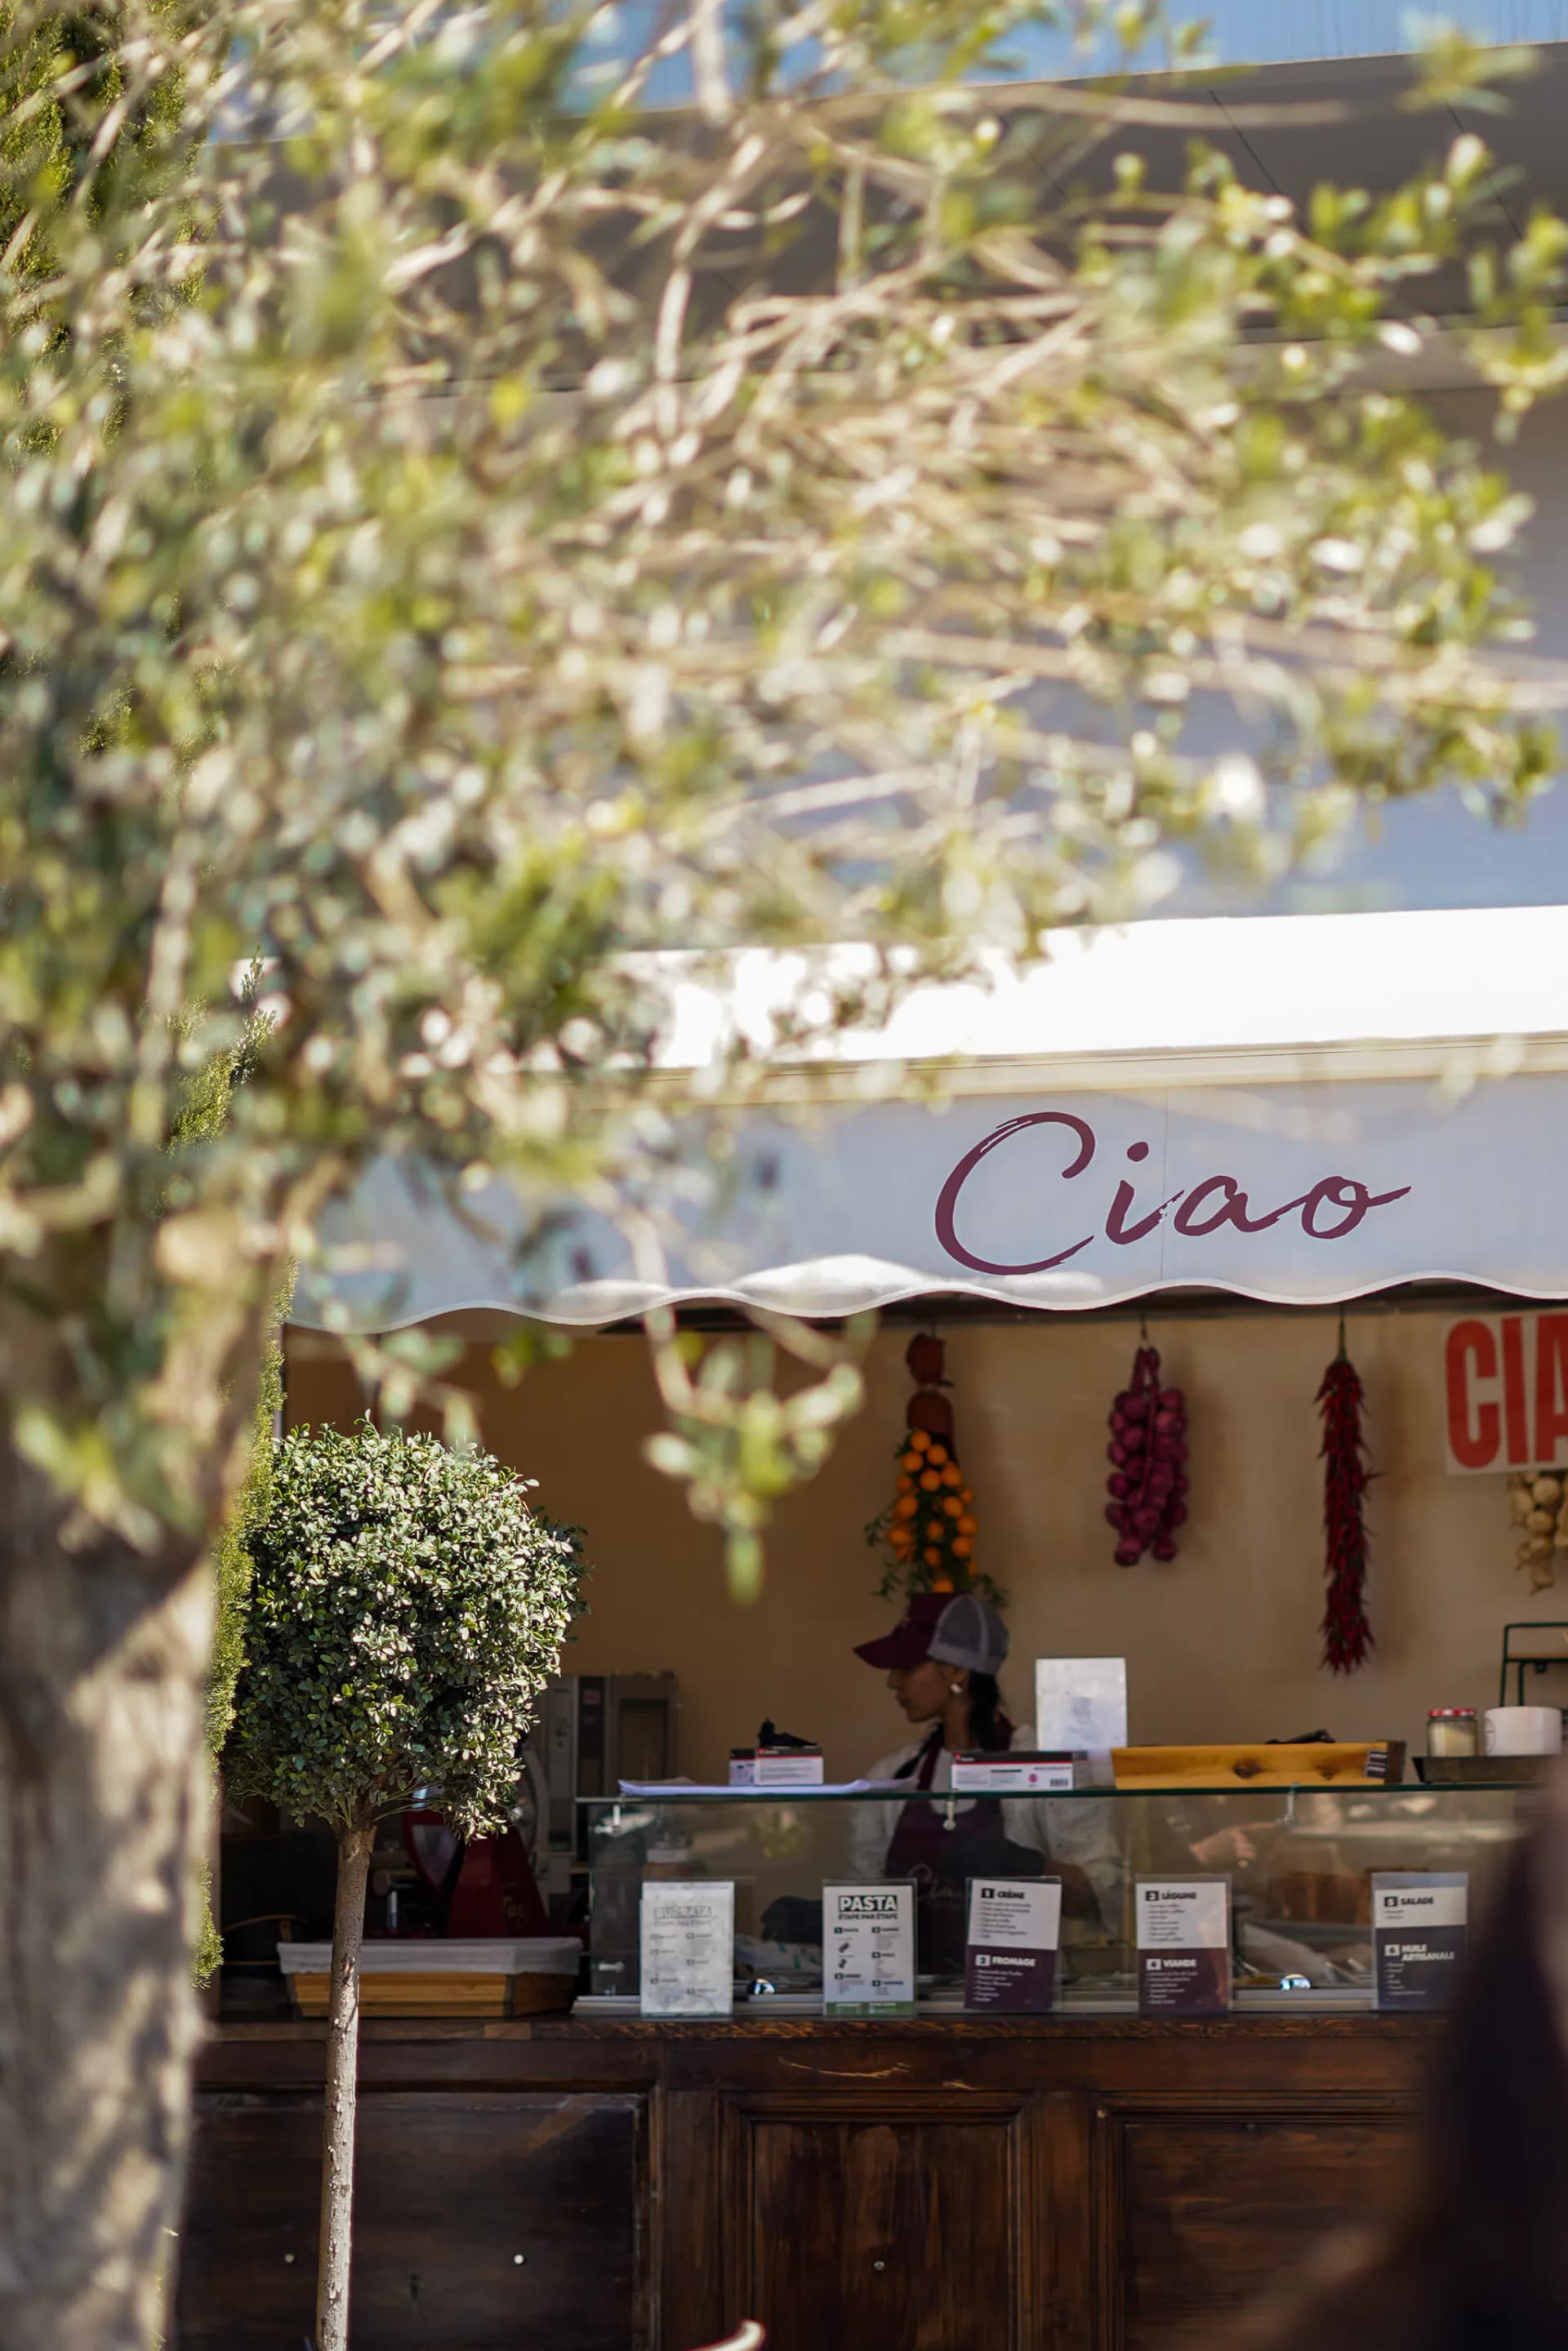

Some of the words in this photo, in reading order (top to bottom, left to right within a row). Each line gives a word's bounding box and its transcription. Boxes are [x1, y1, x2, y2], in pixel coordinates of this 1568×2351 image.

[934, 1111, 1413, 1276] Ciao
[1445, 1314, 1568, 1468] CIA
[840, 1896, 898, 1911] PASTA
[1401, 1897, 1434, 1905] SALADE
